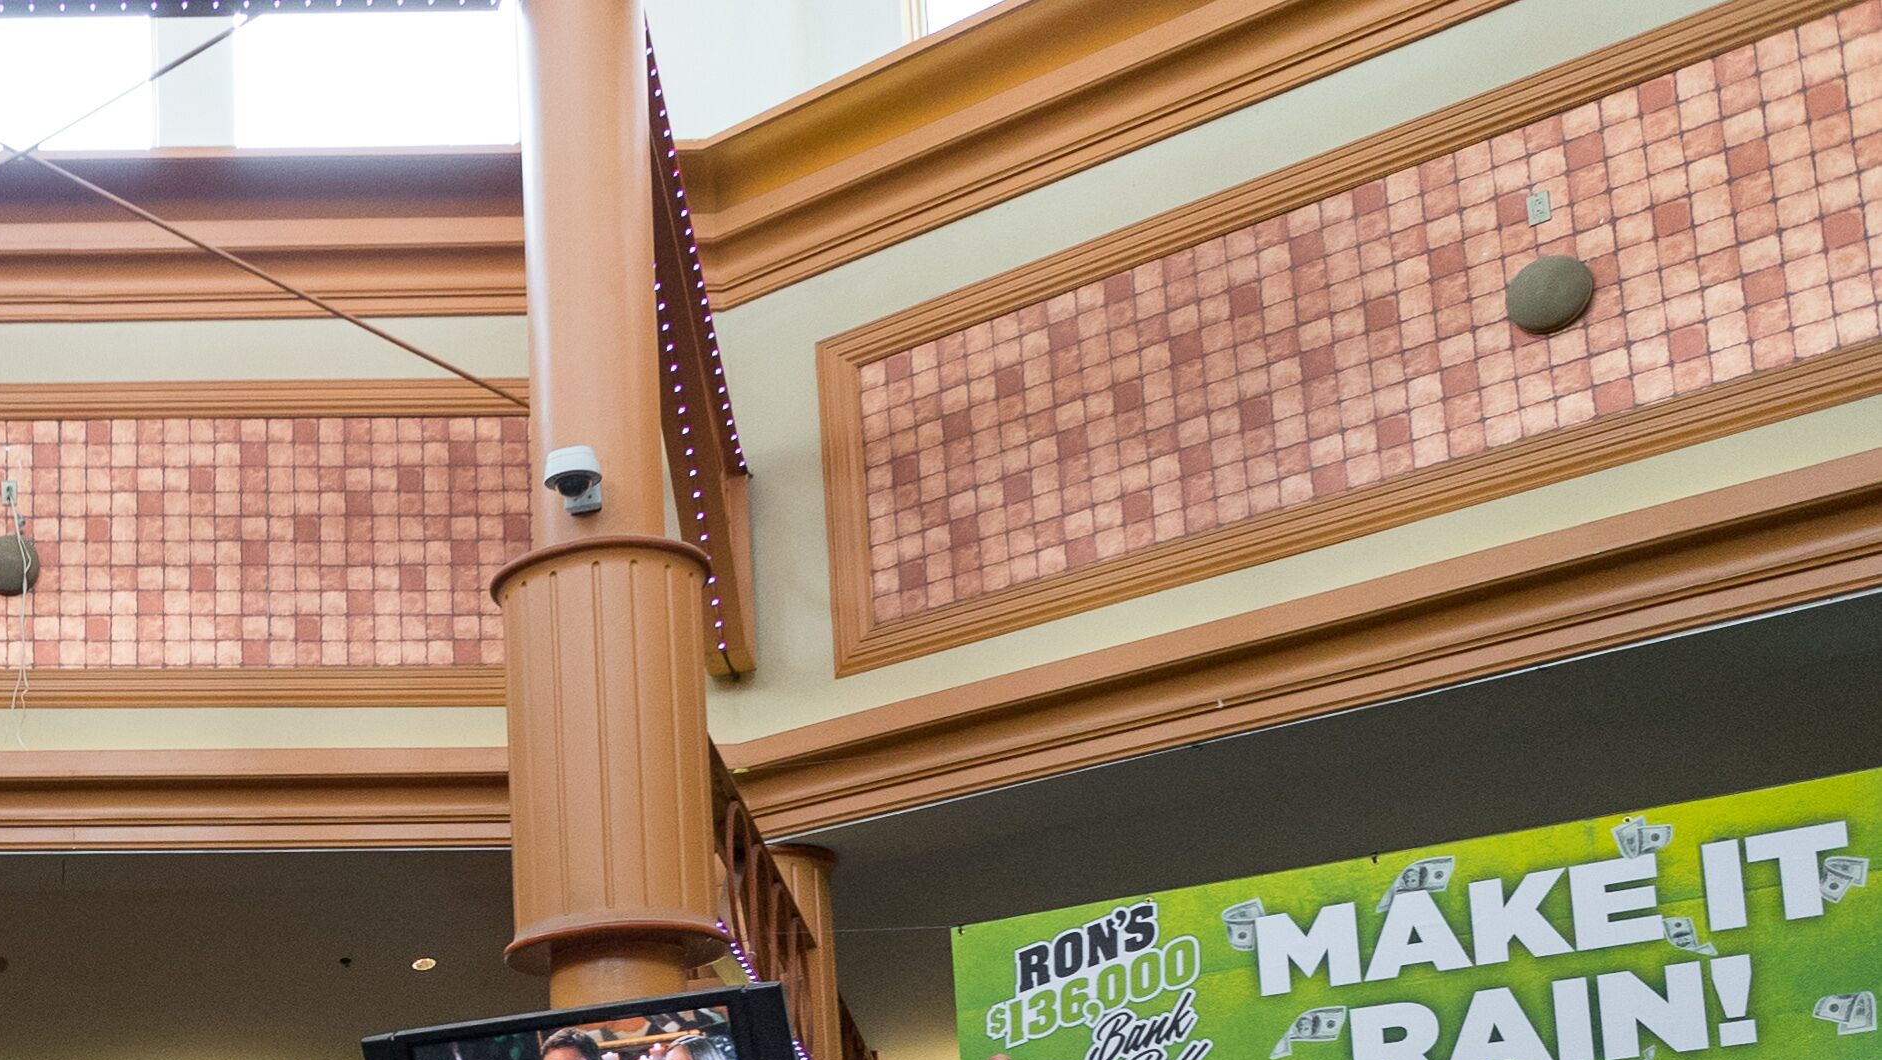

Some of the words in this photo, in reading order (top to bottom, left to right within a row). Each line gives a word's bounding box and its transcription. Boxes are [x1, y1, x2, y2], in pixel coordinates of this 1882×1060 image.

[1018, 904, 1156, 994] RON'S
[1255, 853, 1664, 997] MAKE
[1701, 820, 1849, 932] IT
[990, 938, 1196, 1044] $136,000
